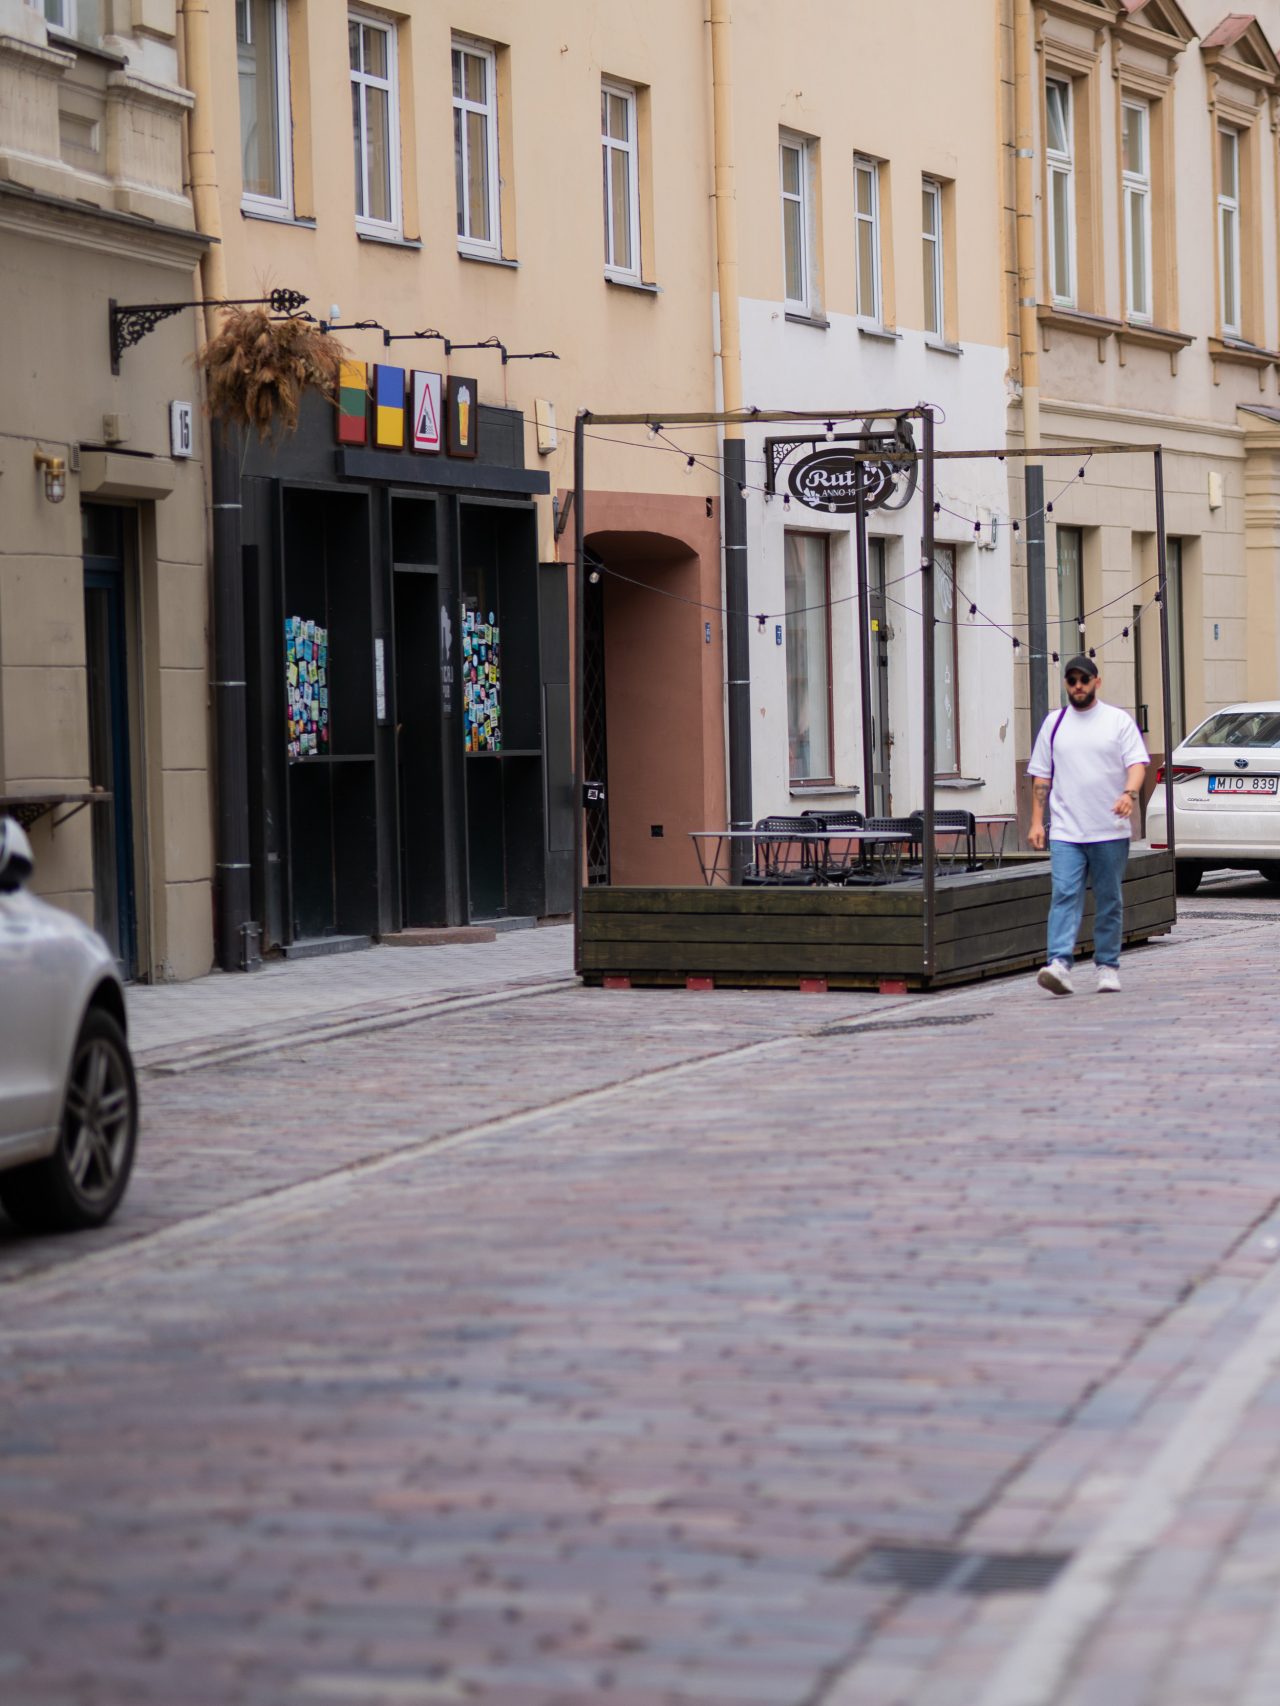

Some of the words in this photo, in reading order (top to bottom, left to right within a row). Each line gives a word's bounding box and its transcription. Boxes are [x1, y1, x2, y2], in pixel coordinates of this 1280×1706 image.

[180, 410, 189, 449] 15
[822, 488, 846, 497] ANNO
[1217, 778, 1244, 789] MIO
[1252, 778, 1275, 789] 839
